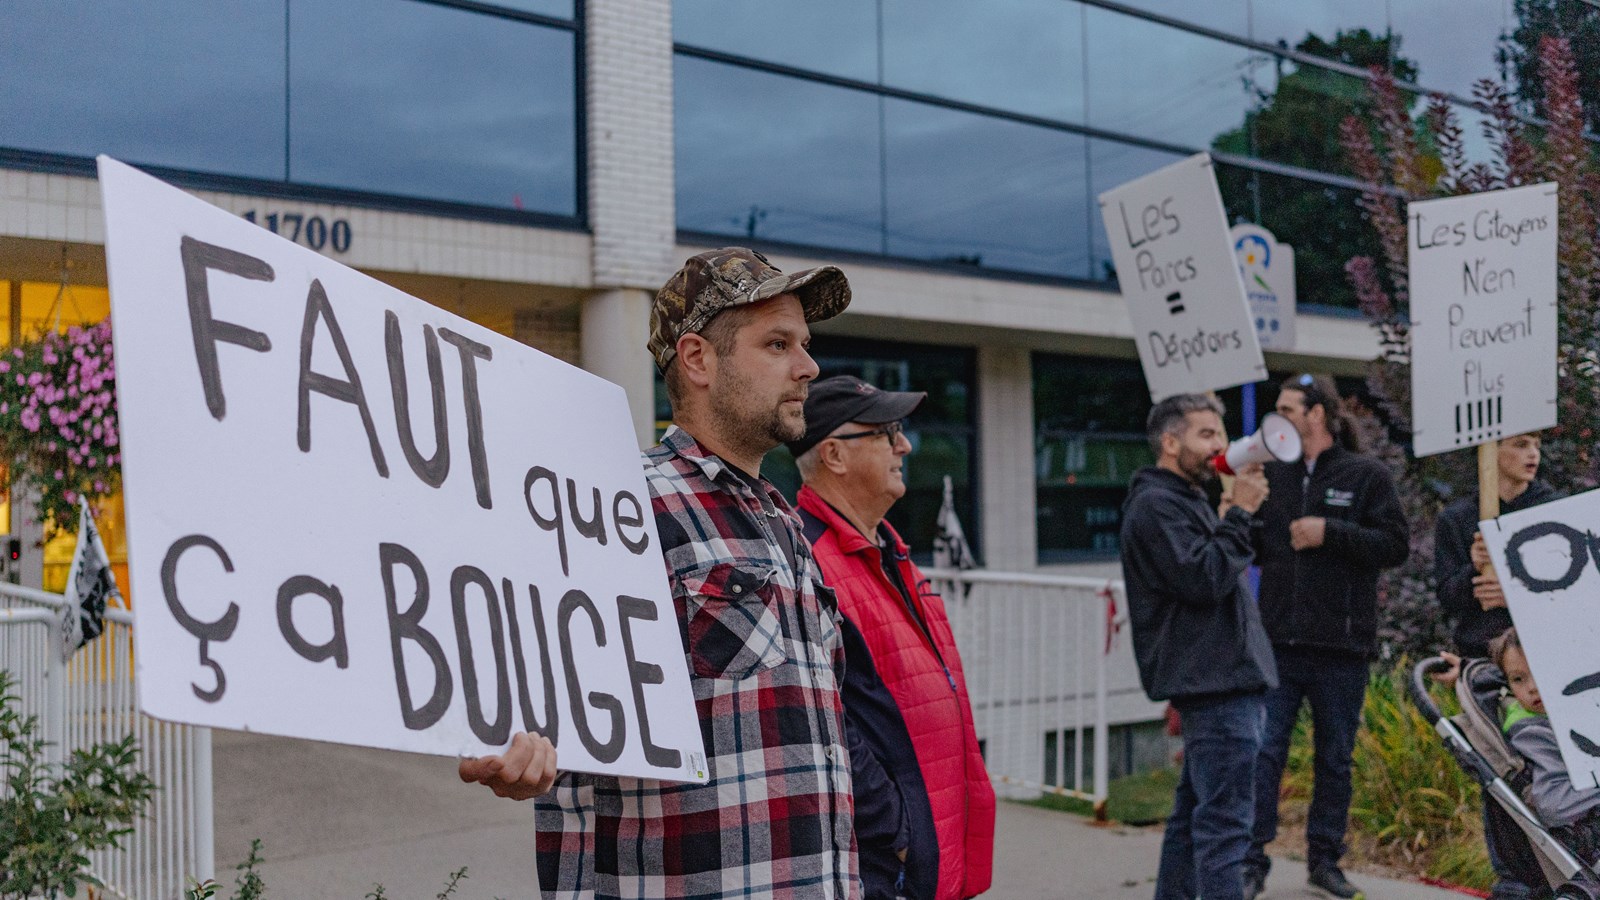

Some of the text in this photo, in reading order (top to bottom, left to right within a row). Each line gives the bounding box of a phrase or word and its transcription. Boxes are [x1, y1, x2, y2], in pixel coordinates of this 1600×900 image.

[1119, 197, 1180, 249] Les
[1416, 209, 1548, 249] Les Citoyens
[1134, 250, 1197, 291] Parcs
[1463, 257, 1516, 296] N'en
[1448, 298, 1534, 350] Peuvent
[1464, 360, 1505, 396] Plus
[181, 235, 649, 576] FAUT que
[379, 542, 682, 769] BOUGE
